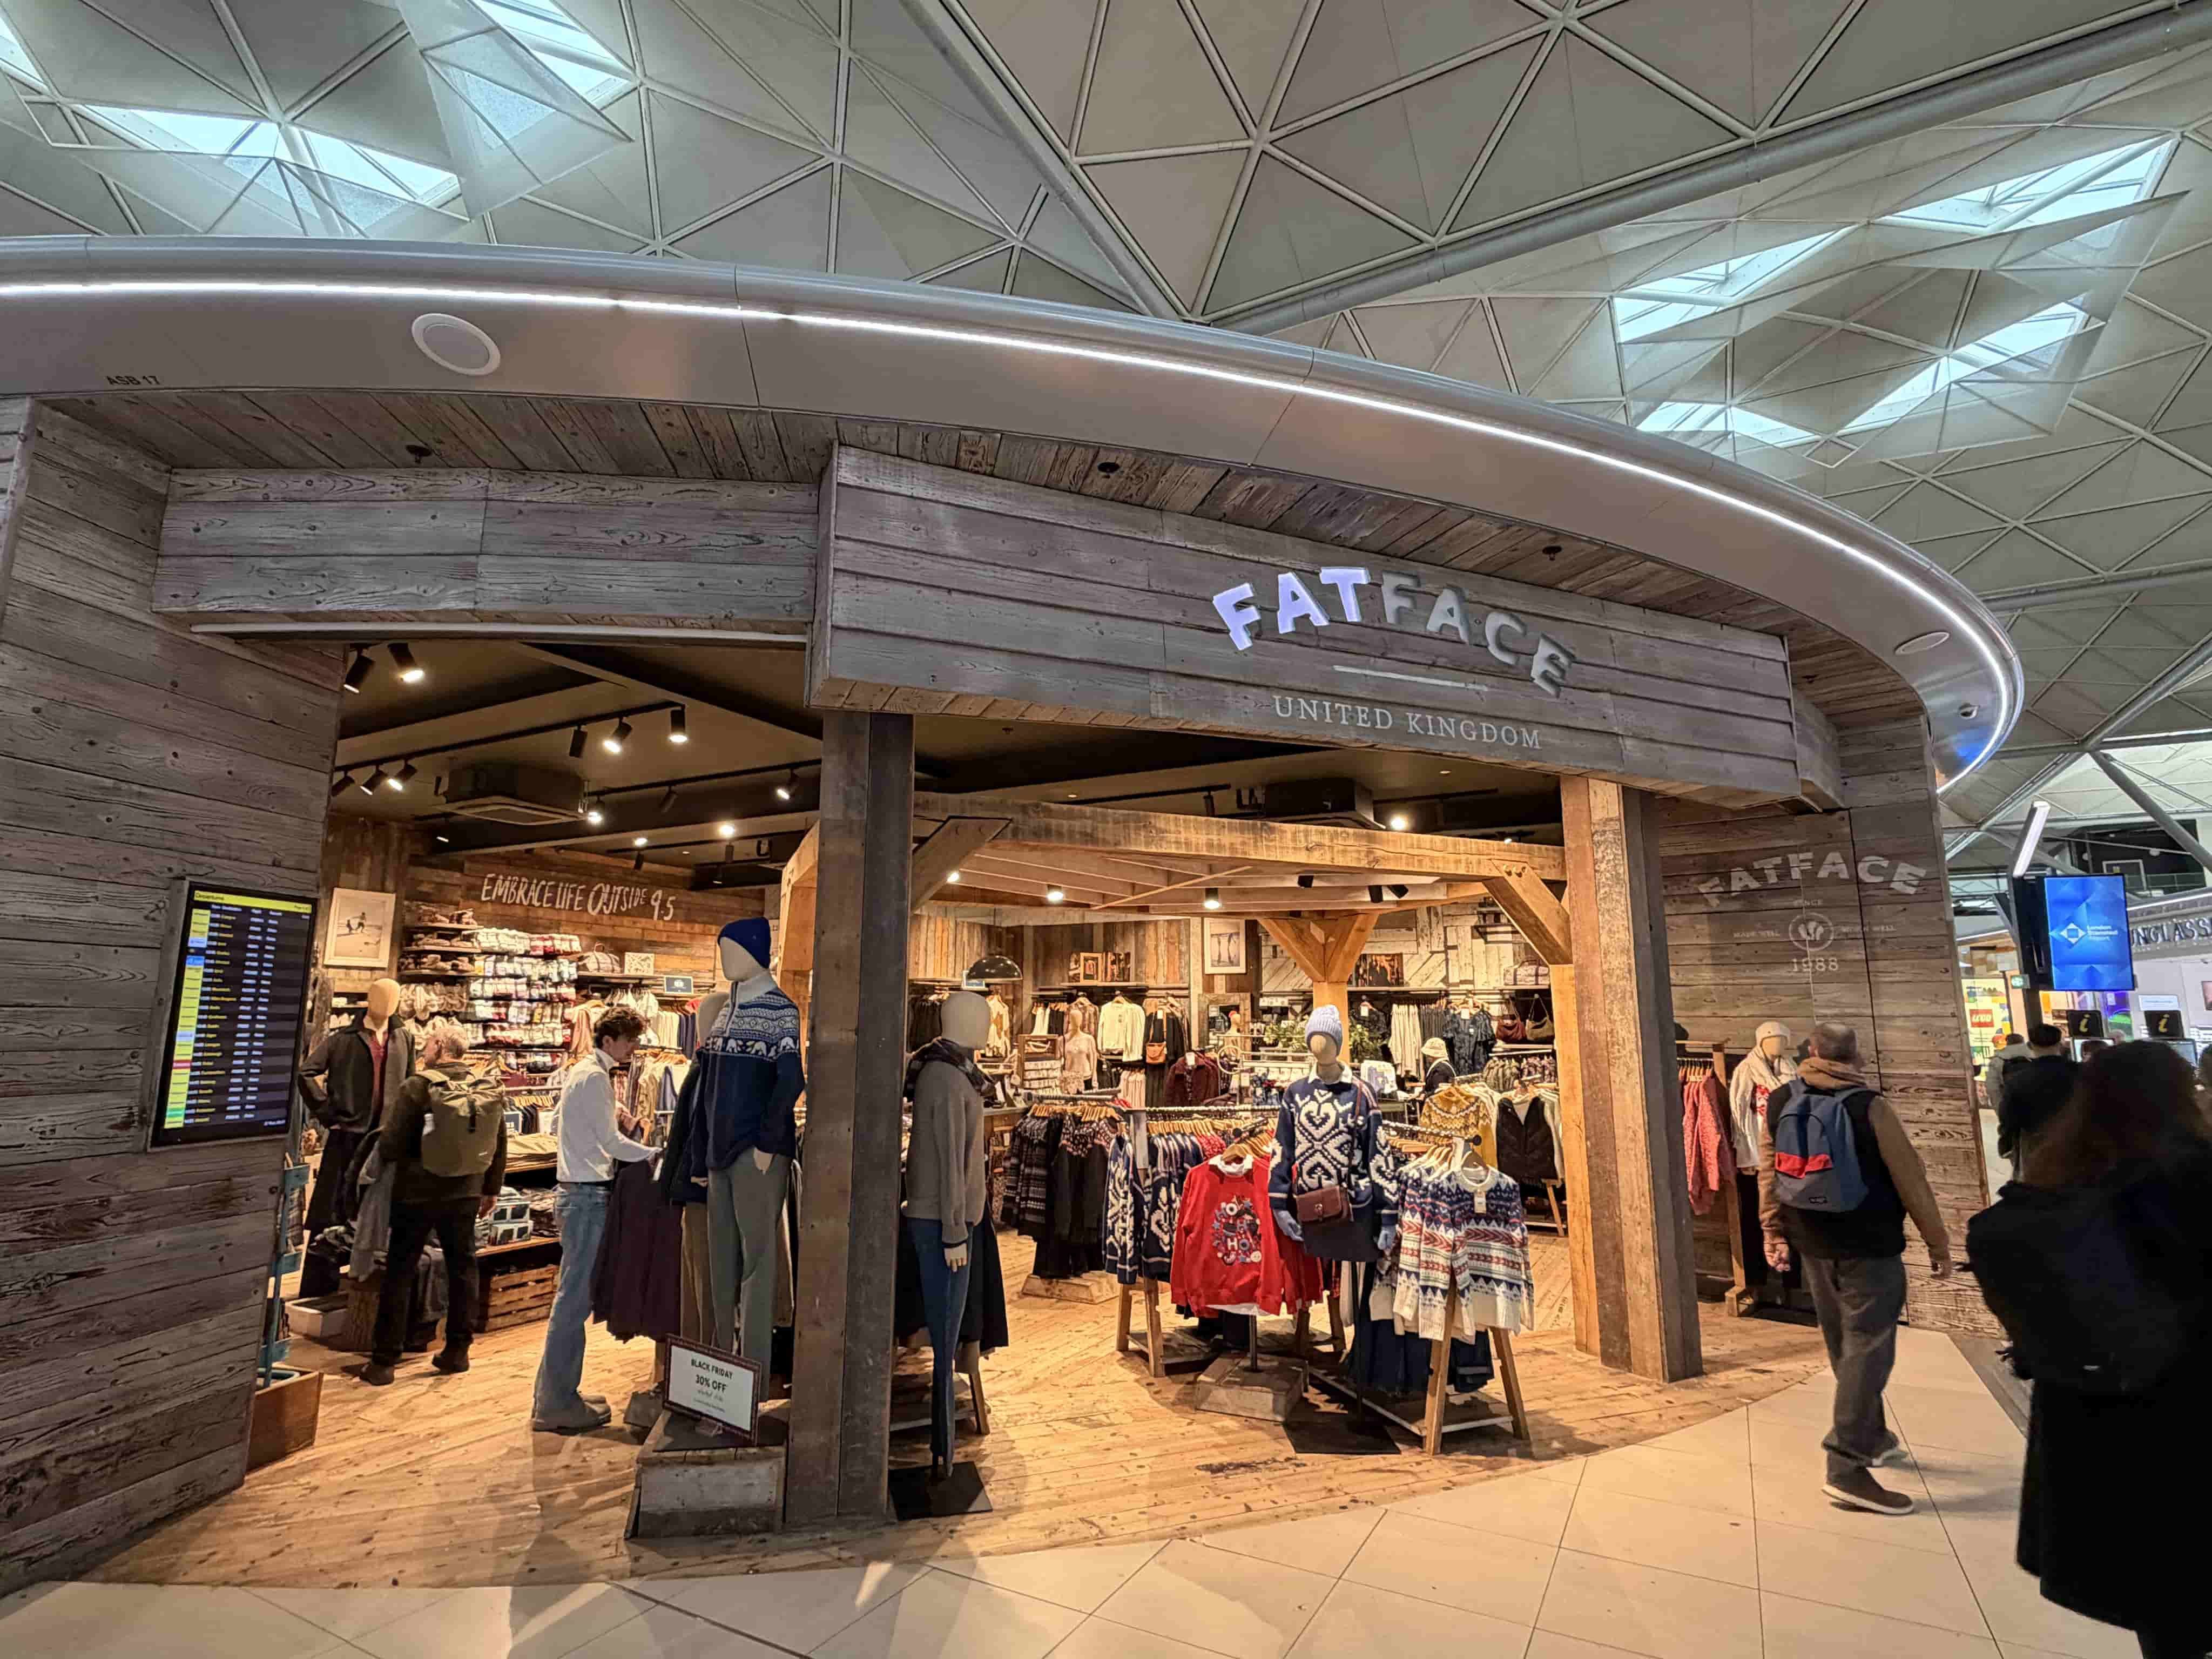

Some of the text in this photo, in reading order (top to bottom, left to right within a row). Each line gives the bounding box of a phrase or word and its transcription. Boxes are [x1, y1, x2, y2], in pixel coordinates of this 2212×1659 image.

[1212, 566, 1576, 699] FATFACE
[1272, 695, 1542, 750] UNITED KINGDOM
[481, 873, 556, 908] EMBRACE
[555, 881, 587, 912] LIFE
[587, 882, 649, 916] OUTSIDE
[1697, 851, 1927, 908] FATFACE
[1791, 957, 1838, 972] 1988
[691, 1359, 733, 1380] BLACK FRIDAY
[695, 1374, 727, 1393] 30% OFF
